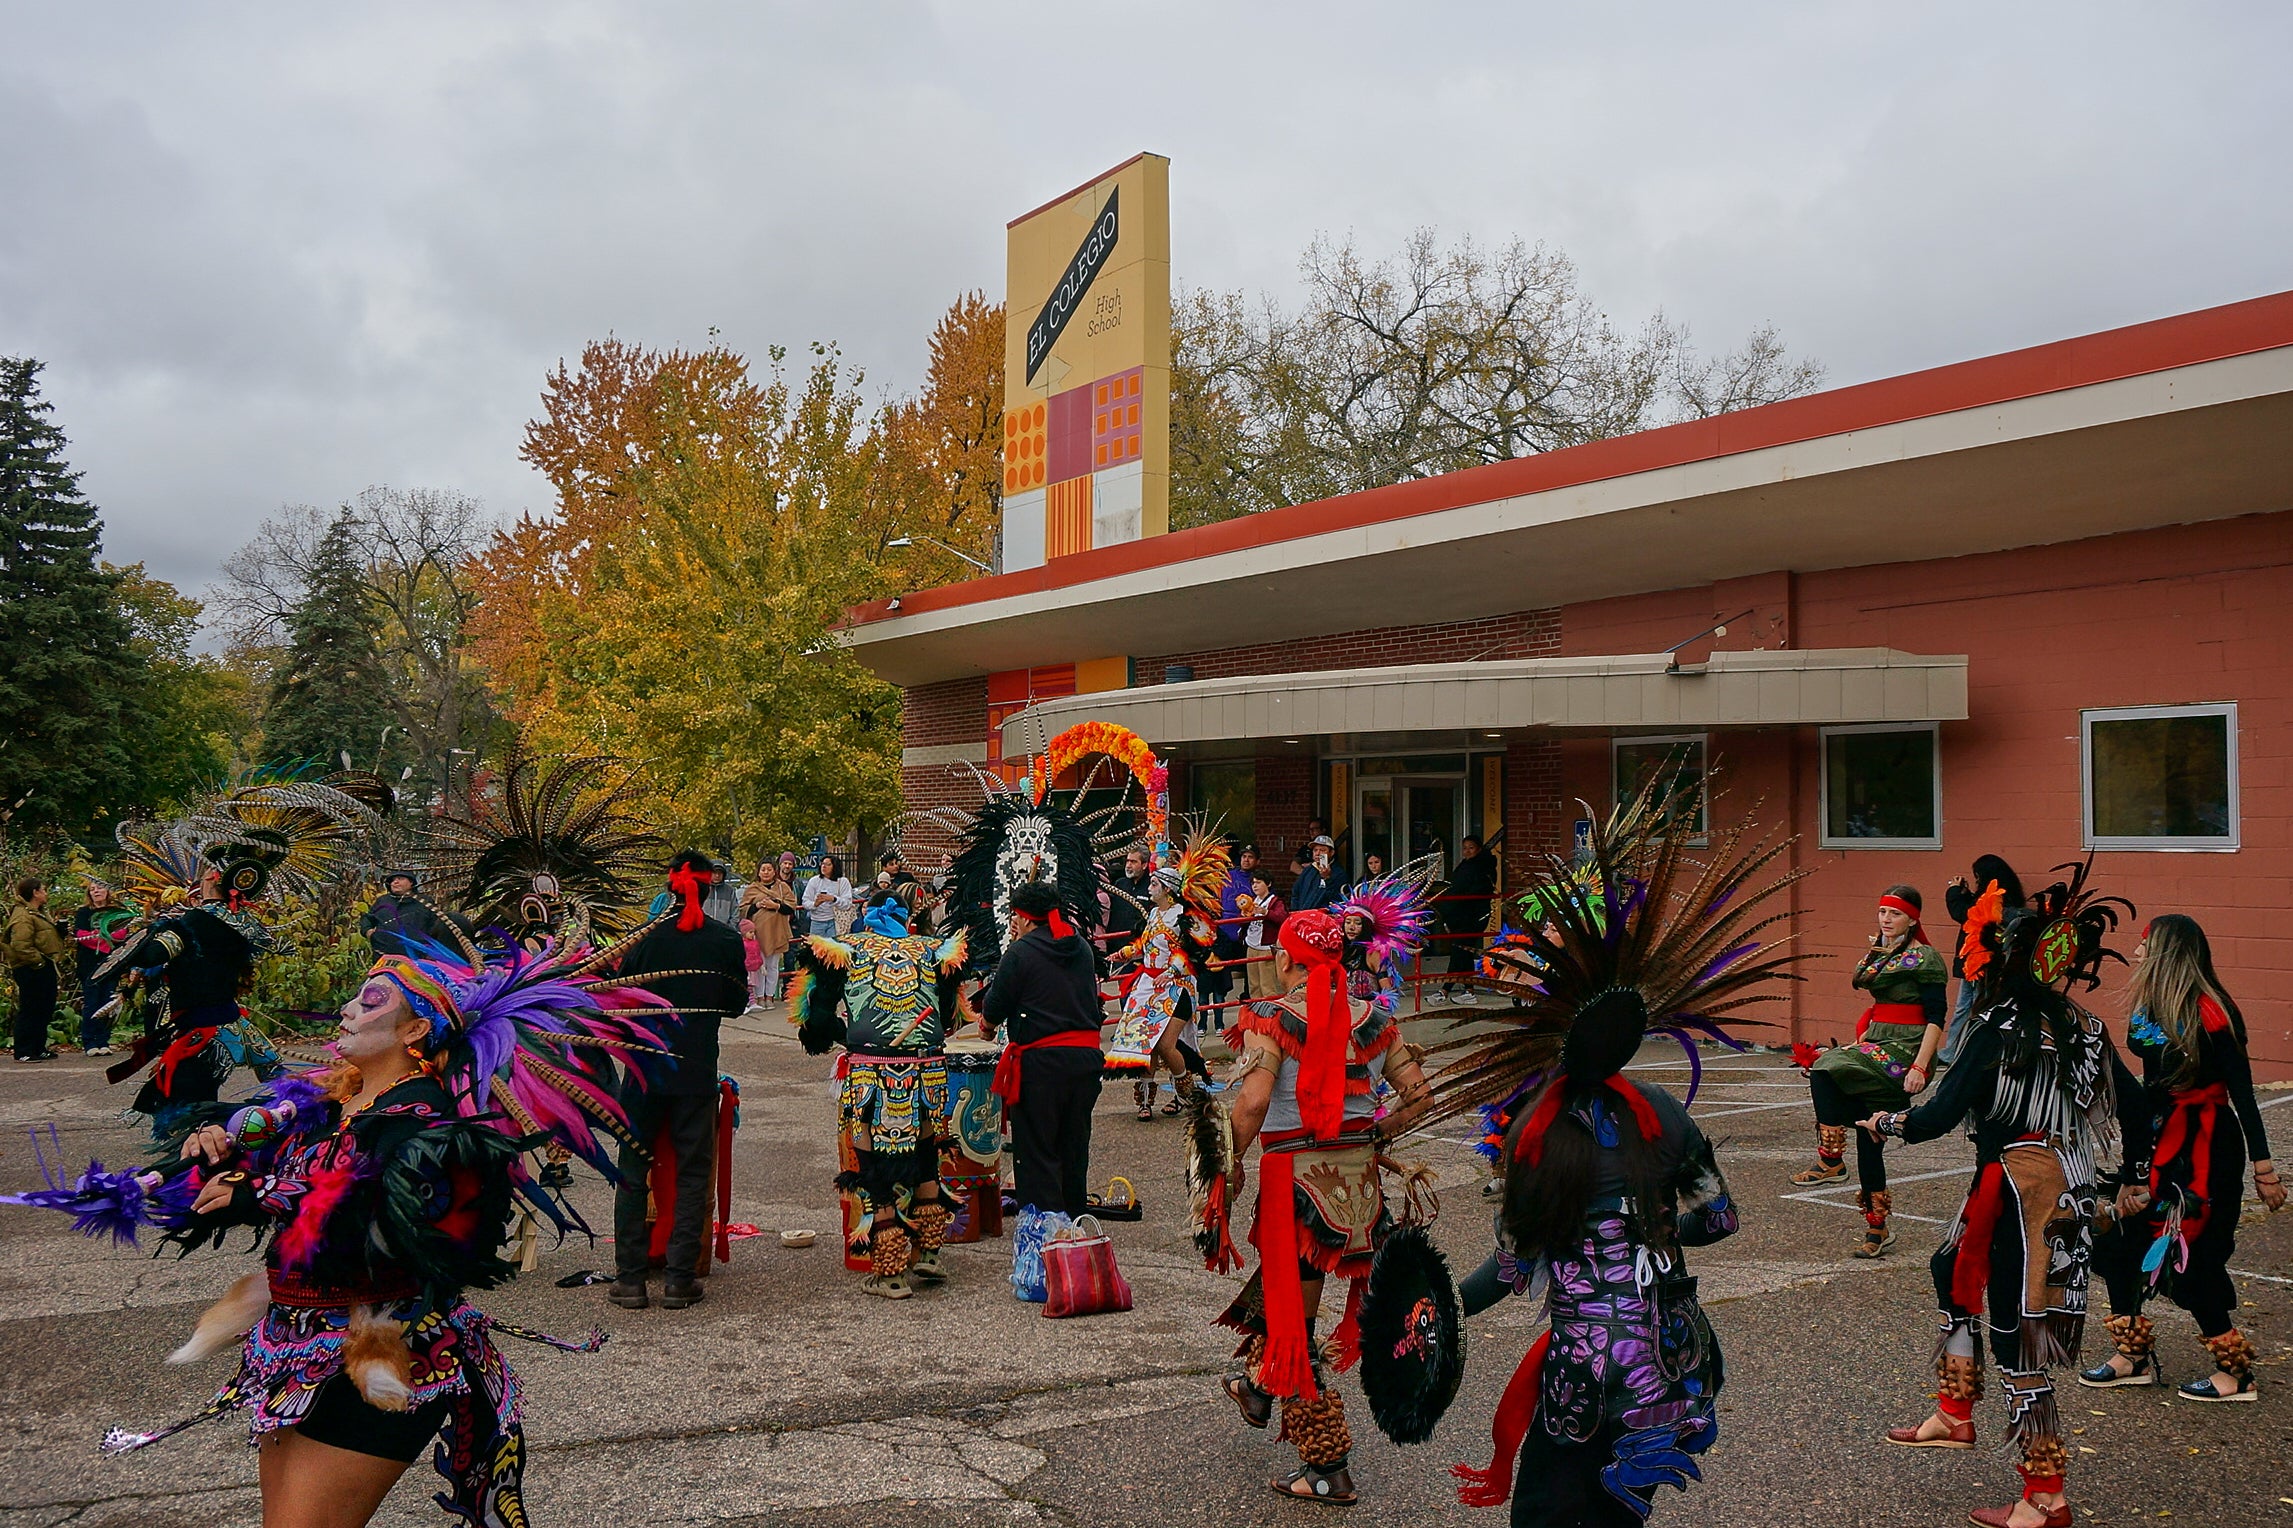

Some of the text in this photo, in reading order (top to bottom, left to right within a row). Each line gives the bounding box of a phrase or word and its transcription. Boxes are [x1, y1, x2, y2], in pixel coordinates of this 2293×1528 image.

[1029, 211, 1116, 366] EL COLEGIO
[1096, 288, 1121, 315] High
[1087, 306, 1122, 338] School
[1336, 766, 1344, 816] WELCOME
[1489, 760, 1497, 814] WELCOME
